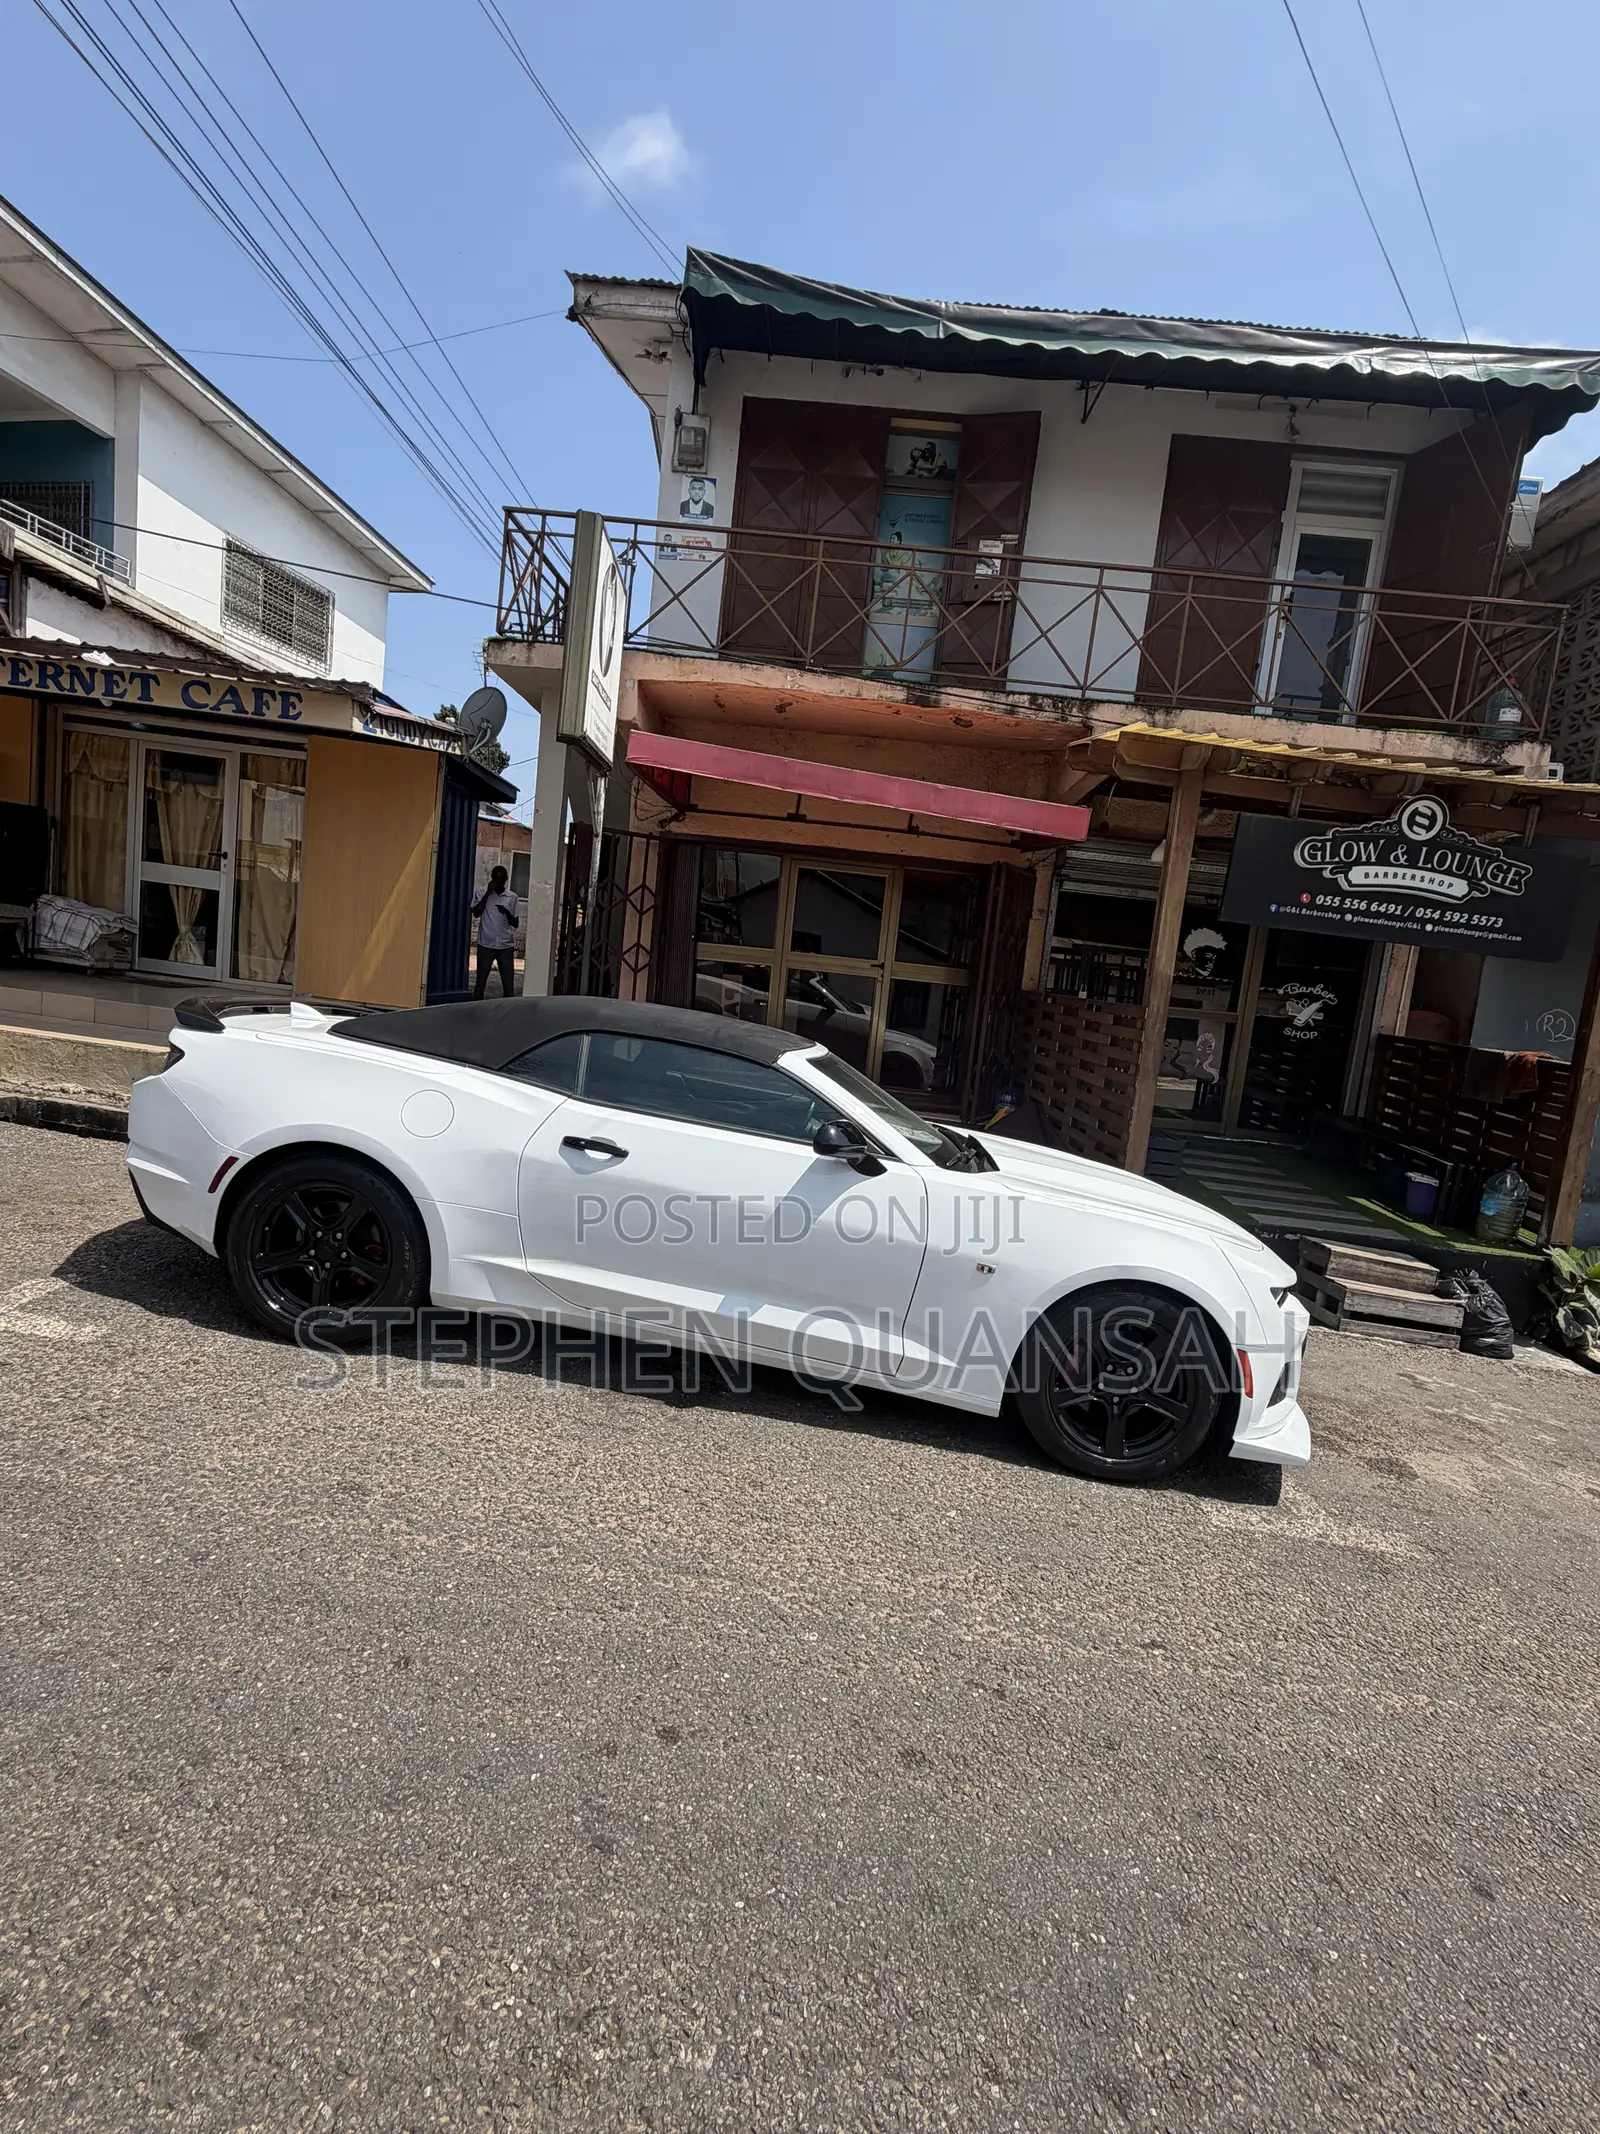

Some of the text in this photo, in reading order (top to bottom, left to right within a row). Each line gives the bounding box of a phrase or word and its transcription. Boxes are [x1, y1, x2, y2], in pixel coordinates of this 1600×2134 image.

[0, 655, 303, 721] ERNET CAFE
[1303, 839, 1526, 890] GLOW & LOUNGE
[1364, 871, 1454, 890] BARBERSHOP
[1279, 905, 1300, 914] @G&L
[1301, 908, 1341, 920] Barbershop
[1433, 924, 1522, 942] glowandlounge@gmail.com
[1315, 894, 1504, 928] 055 556 6491 / 054 592 5573
[1279, 983, 1338, 1004] Barber
[1283, 1027, 1318, 1040] SHOP
